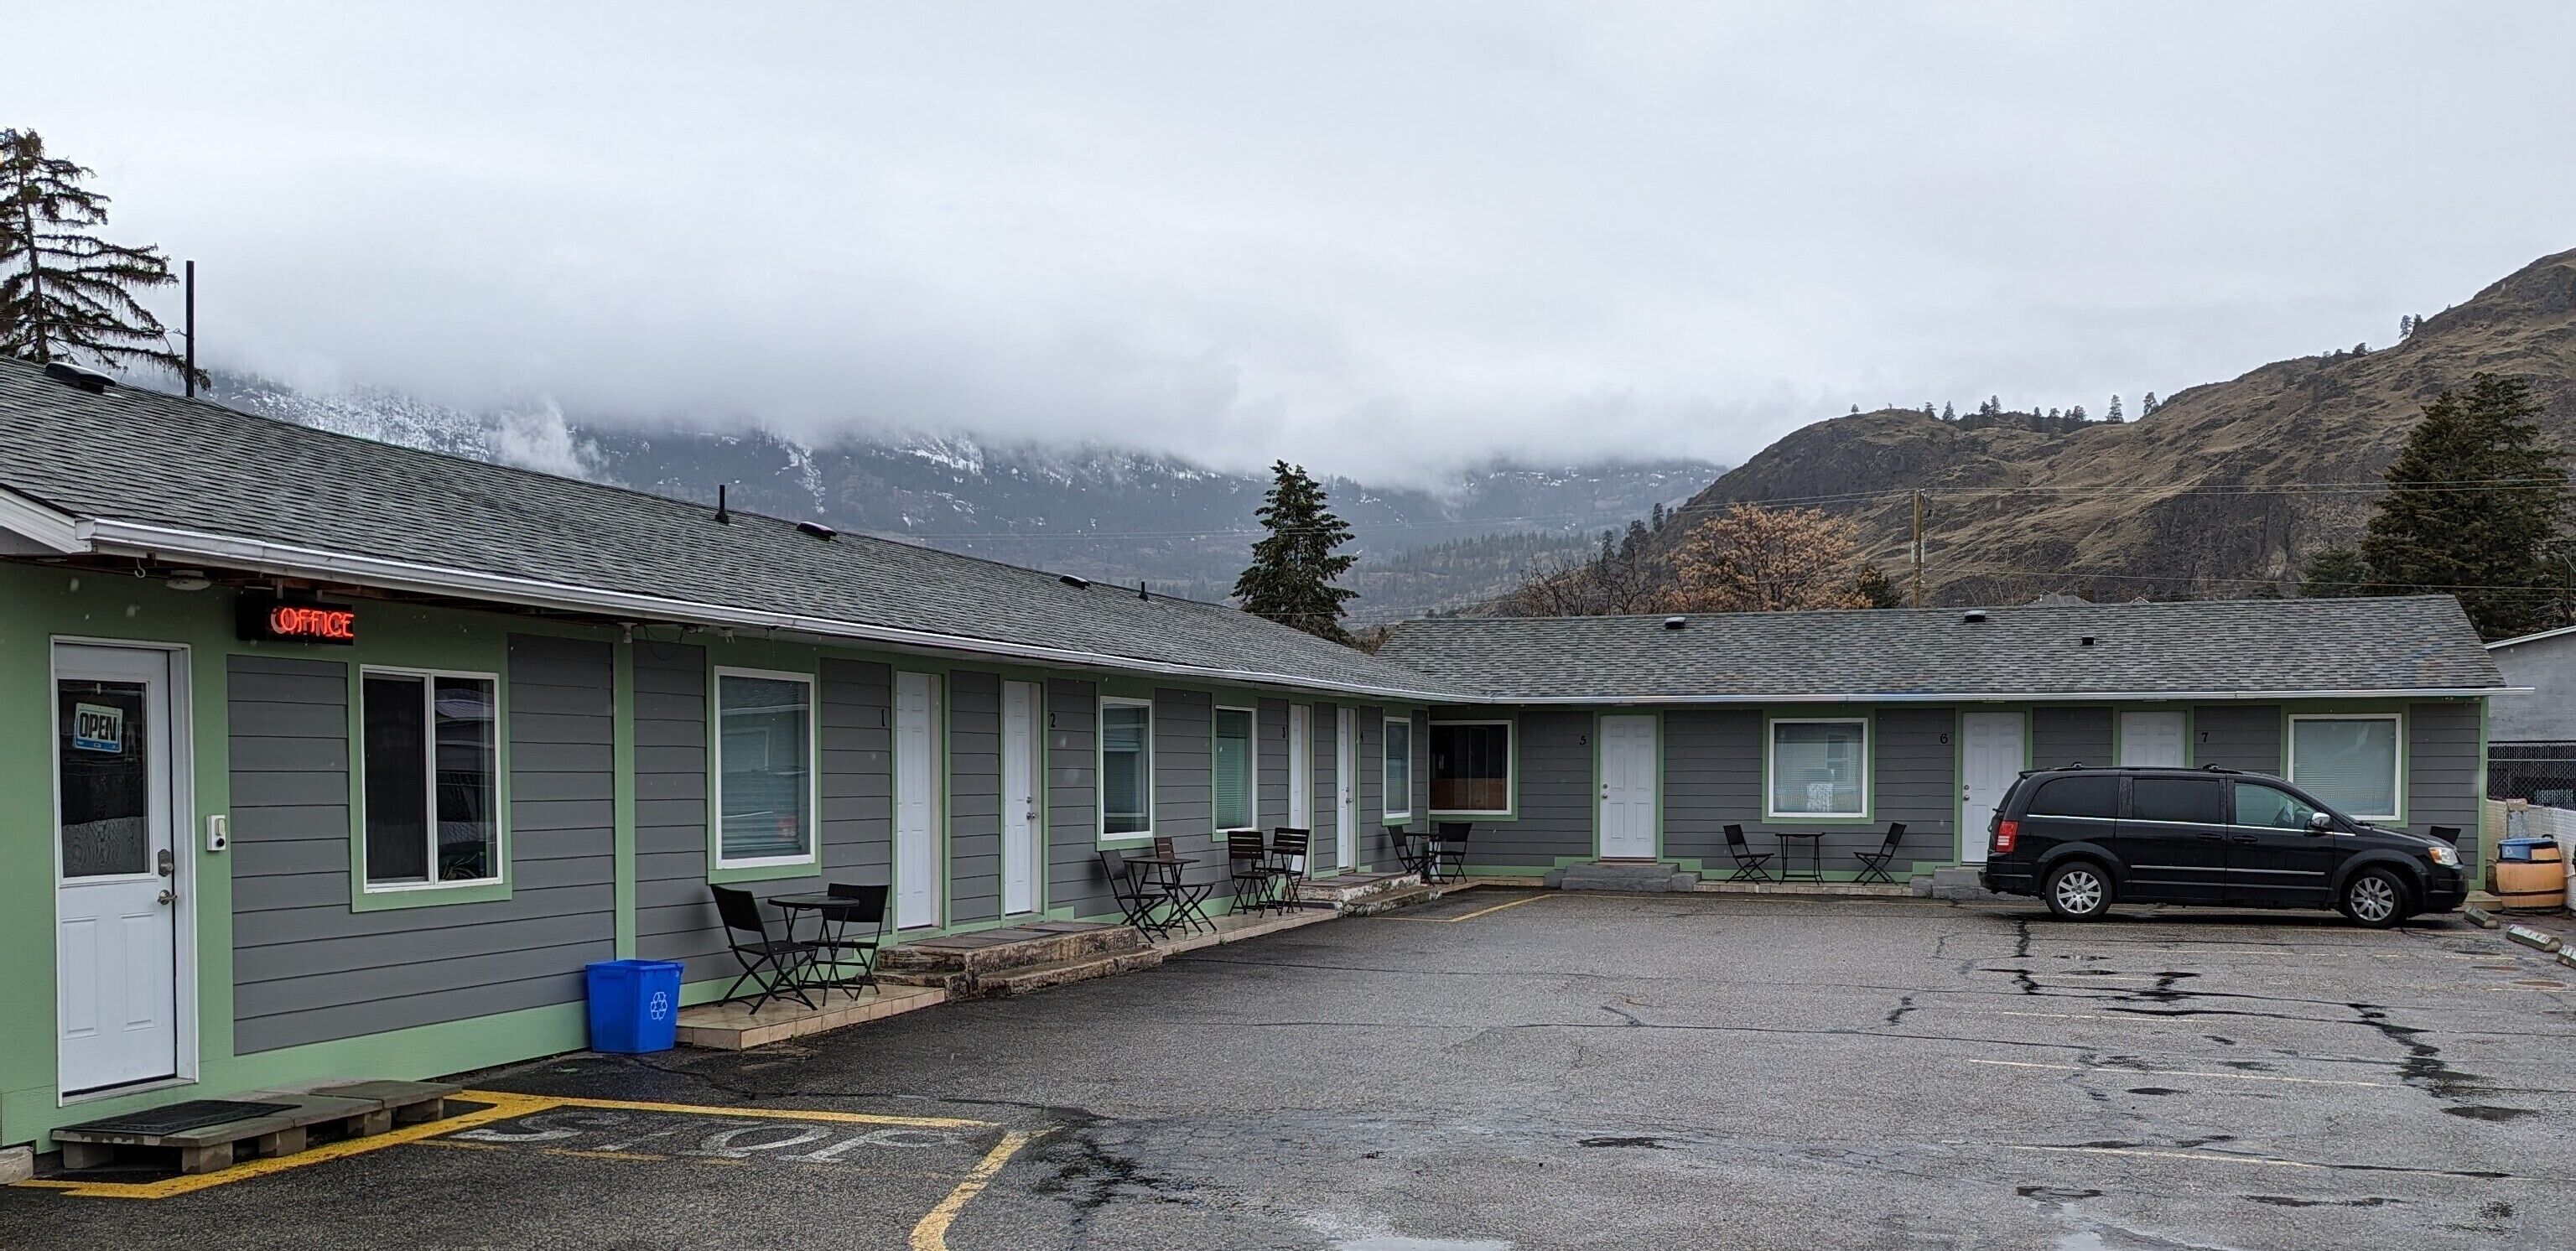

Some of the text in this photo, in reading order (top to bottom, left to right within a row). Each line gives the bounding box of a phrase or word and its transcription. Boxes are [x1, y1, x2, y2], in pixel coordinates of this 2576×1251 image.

[271, 607, 355, 638] OFFICE
[880, 709, 886, 727] 1
[1050, 712, 1056, 728] 2
[79, 712, 118, 741] OPEN
[1579, 735, 1587, 745] 5
[1940, 733, 1948, 744] 6
[2201, 731, 2209, 743] 7
